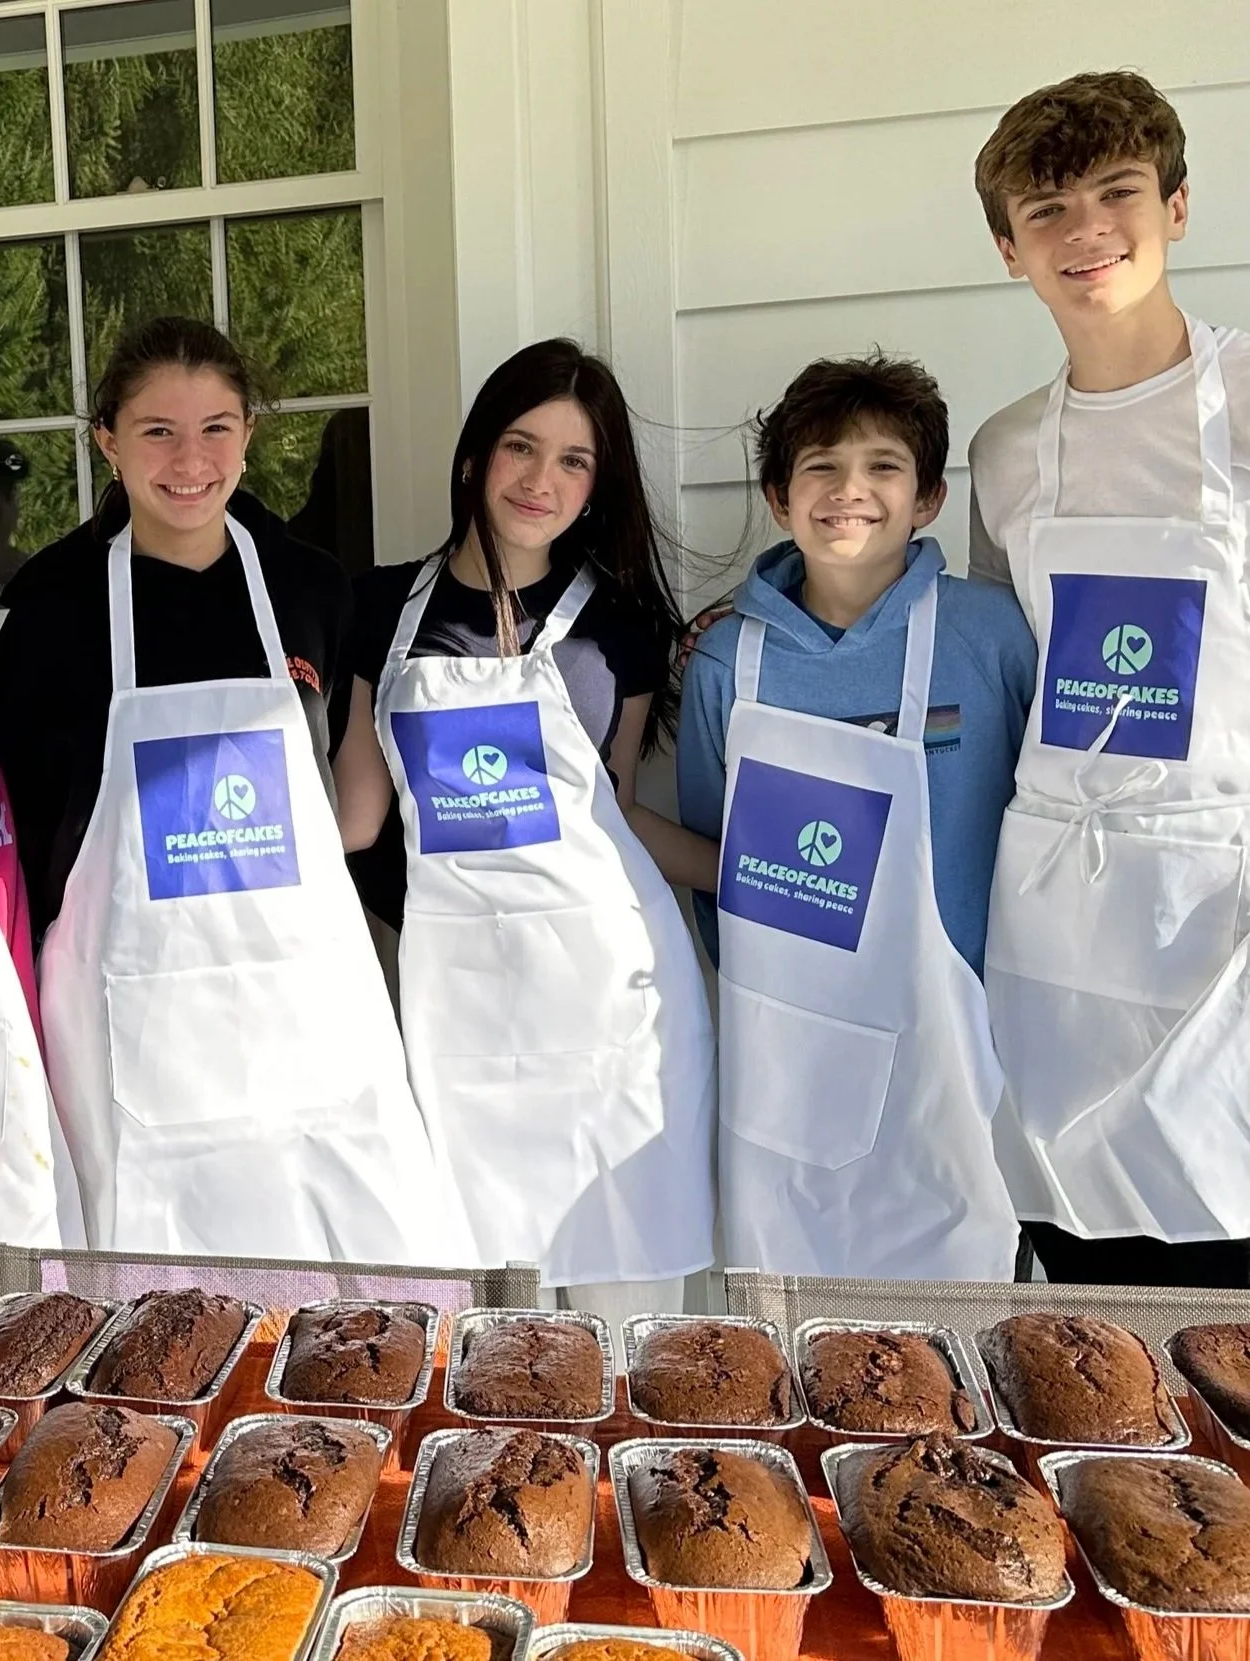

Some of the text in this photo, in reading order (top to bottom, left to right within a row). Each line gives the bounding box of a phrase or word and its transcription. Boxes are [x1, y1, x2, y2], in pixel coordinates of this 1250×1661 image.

[1056, 678, 1179, 705] PEACEOFCAKES
[1055, 698, 1178, 721] Baking cakes, shring peace
[431, 786, 540, 809] PEACEOFCAKES
[436, 811, 462, 821] Baking
[486, 806, 516, 818] sharing
[516, 802, 544, 815] peace
[165, 824, 284, 851] PEACEOFCAKES
[167, 845, 286, 864] Baking cakes, sharing peace
[738, 854, 859, 901] PEACEOFCAKES
[735, 872, 854, 915] Baking cakes, sharing peace
